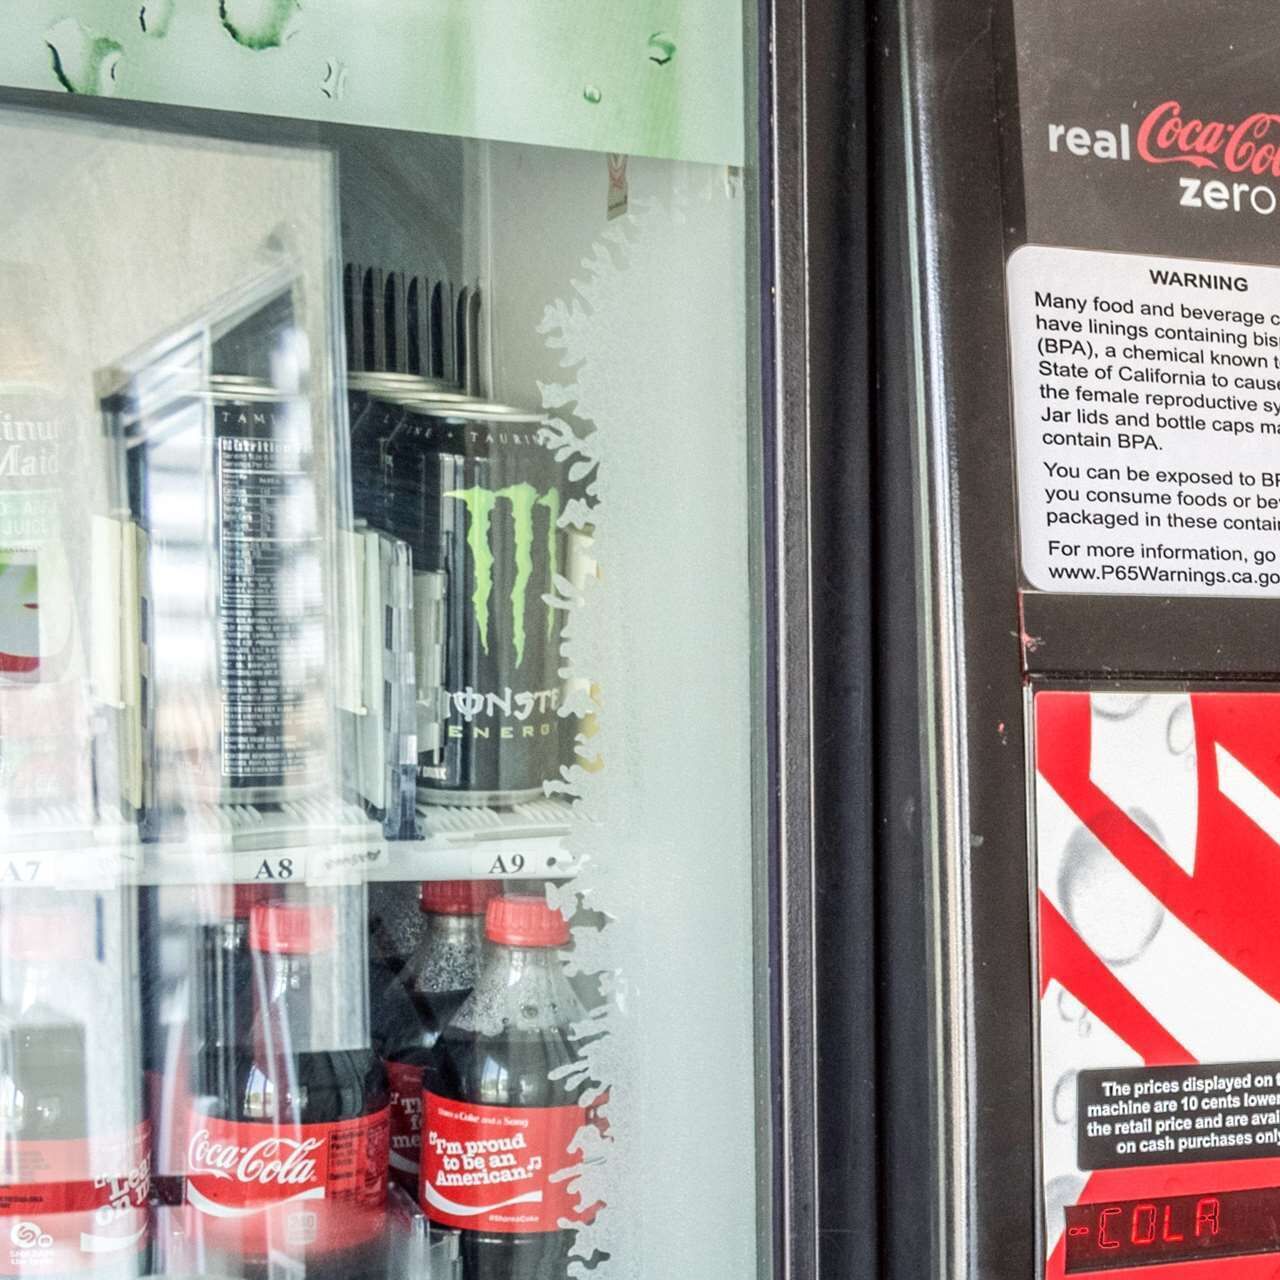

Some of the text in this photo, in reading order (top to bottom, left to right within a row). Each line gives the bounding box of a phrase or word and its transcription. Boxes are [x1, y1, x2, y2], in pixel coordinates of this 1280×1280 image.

[1048, 123, 1130, 160] real
[1179, 177, 1276, 214] zero
[1149, 269, 1248, 292] WARNING
[1034, 291, 1087, 312] Many
[1092, 296, 1134, 314] food
[1140, 302, 1174, 317] and
[1180, 303, 1264, 324] beverage
[1036, 314, 1082, 332] have
[1089, 318, 1148, 340] linings
[1154, 327, 1247, 348] containing
[255, 858, 294, 879] A8
[488, 854, 525, 874] A9
[1101, 1081, 1131, 1096] The
[1134, 1079, 1179, 1098] prices
[1182, 1073, 1251, 1093] displayed
[1254, 1074, 1273, 1087] on
[1087, 1099, 1151, 1117] machine
[1153, 1100, 1177, 1113] are
[1180, 1095, 1198, 1110] 10
[1200, 1093, 1240, 1110] cents
[1086, 1121, 1112, 1137] the
[1114, 1117, 1152, 1134] retail
[1155, 1116, 1192, 1134] price
[1194, 1112, 1222, 1129] and
[1225, 1114, 1248, 1127] are
[465, 1132, 526, 1156] proud
[1116, 1141, 1136, 1153] on
[1139, 1135, 1175, 1152] cash
[1178, 1132, 1252, 1152] purchases
[188, 1130, 326, 1185] Coca-Cola
[443, 1153, 517, 1170] to be an
